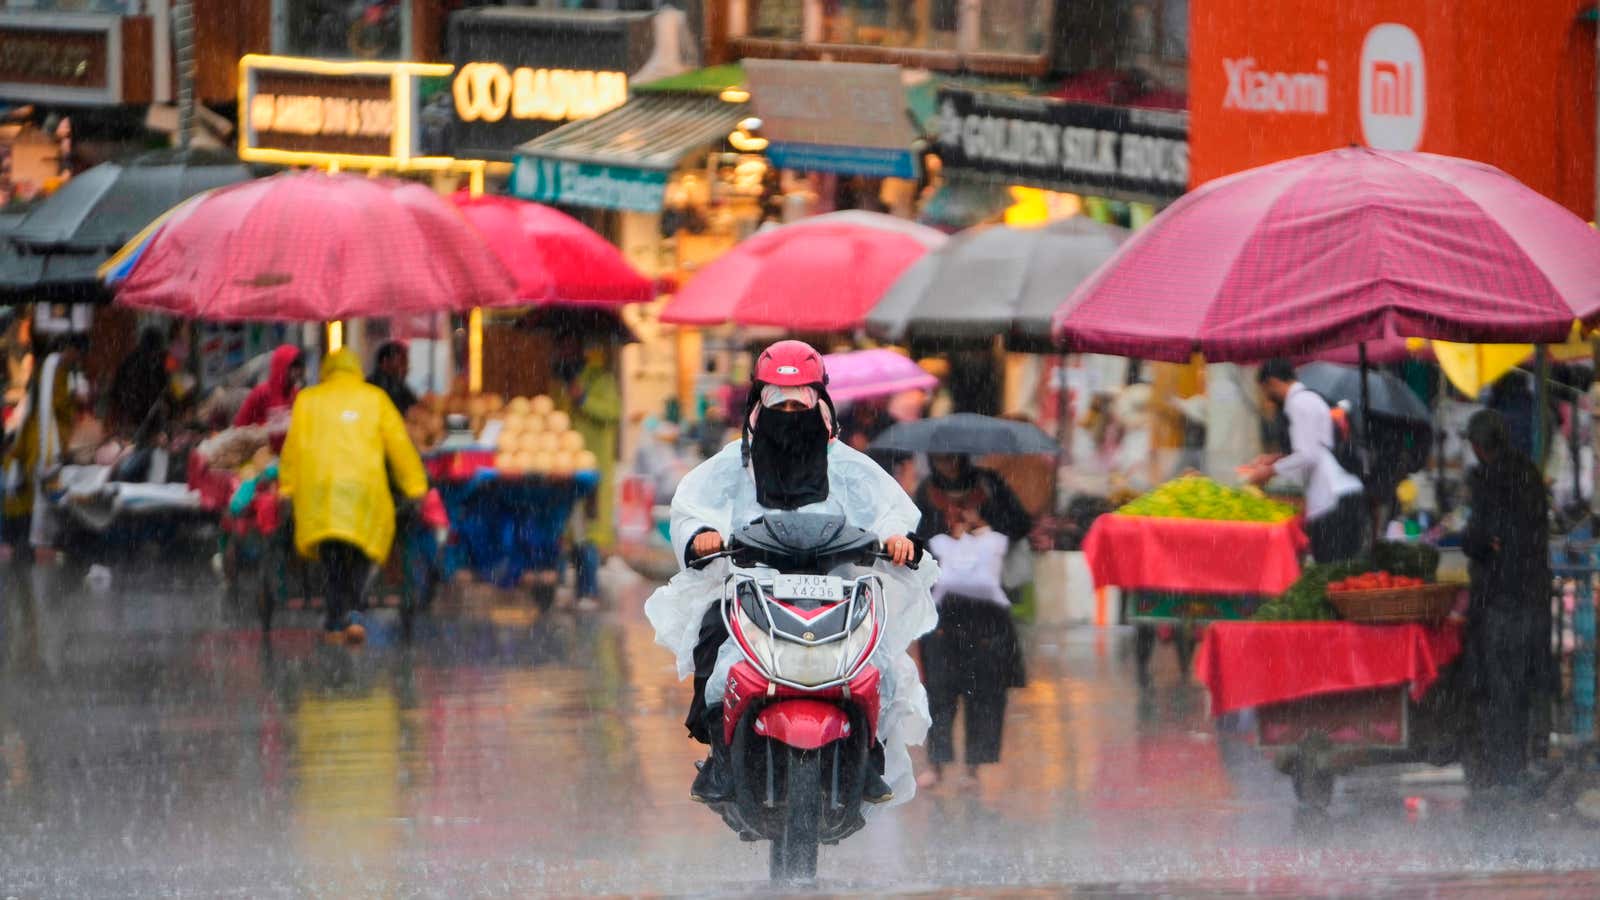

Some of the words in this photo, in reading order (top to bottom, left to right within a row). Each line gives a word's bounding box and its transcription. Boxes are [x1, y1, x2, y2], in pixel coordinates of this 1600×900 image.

[1222, 56, 1328, 115] Xiaomi
[963, 114, 1062, 166] GOLDEN
[1063, 126, 1120, 174] SILK
[1121, 132, 1188, 185] HOUS
[792, 584, 834, 598] X4236
